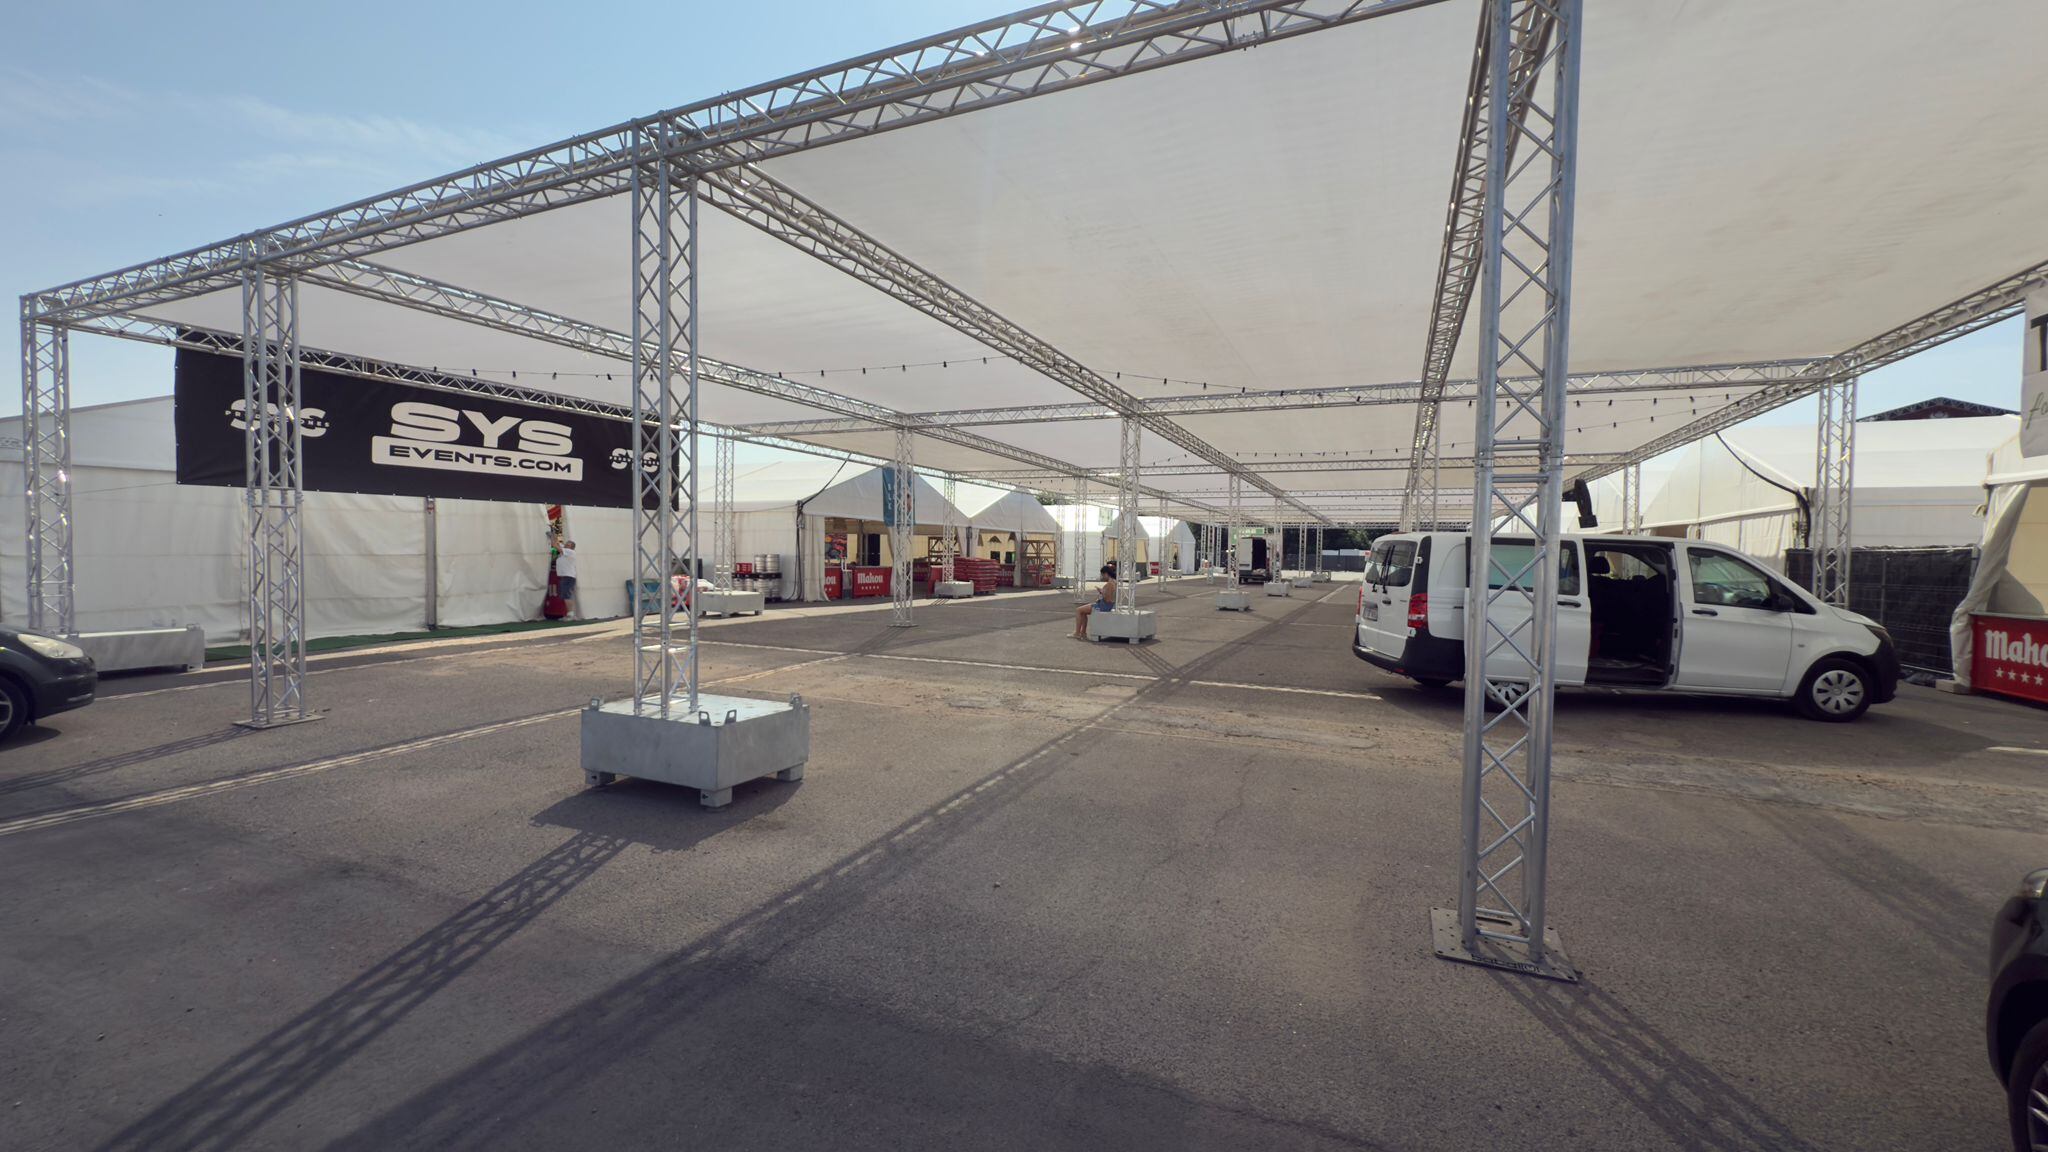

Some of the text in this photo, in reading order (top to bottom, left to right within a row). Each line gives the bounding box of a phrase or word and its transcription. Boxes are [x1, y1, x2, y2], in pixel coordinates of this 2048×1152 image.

[390, 401, 573, 456] SYS
[389, 444, 572, 473] EVENTS.COM
[857, 572, 884, 584] Mahou
